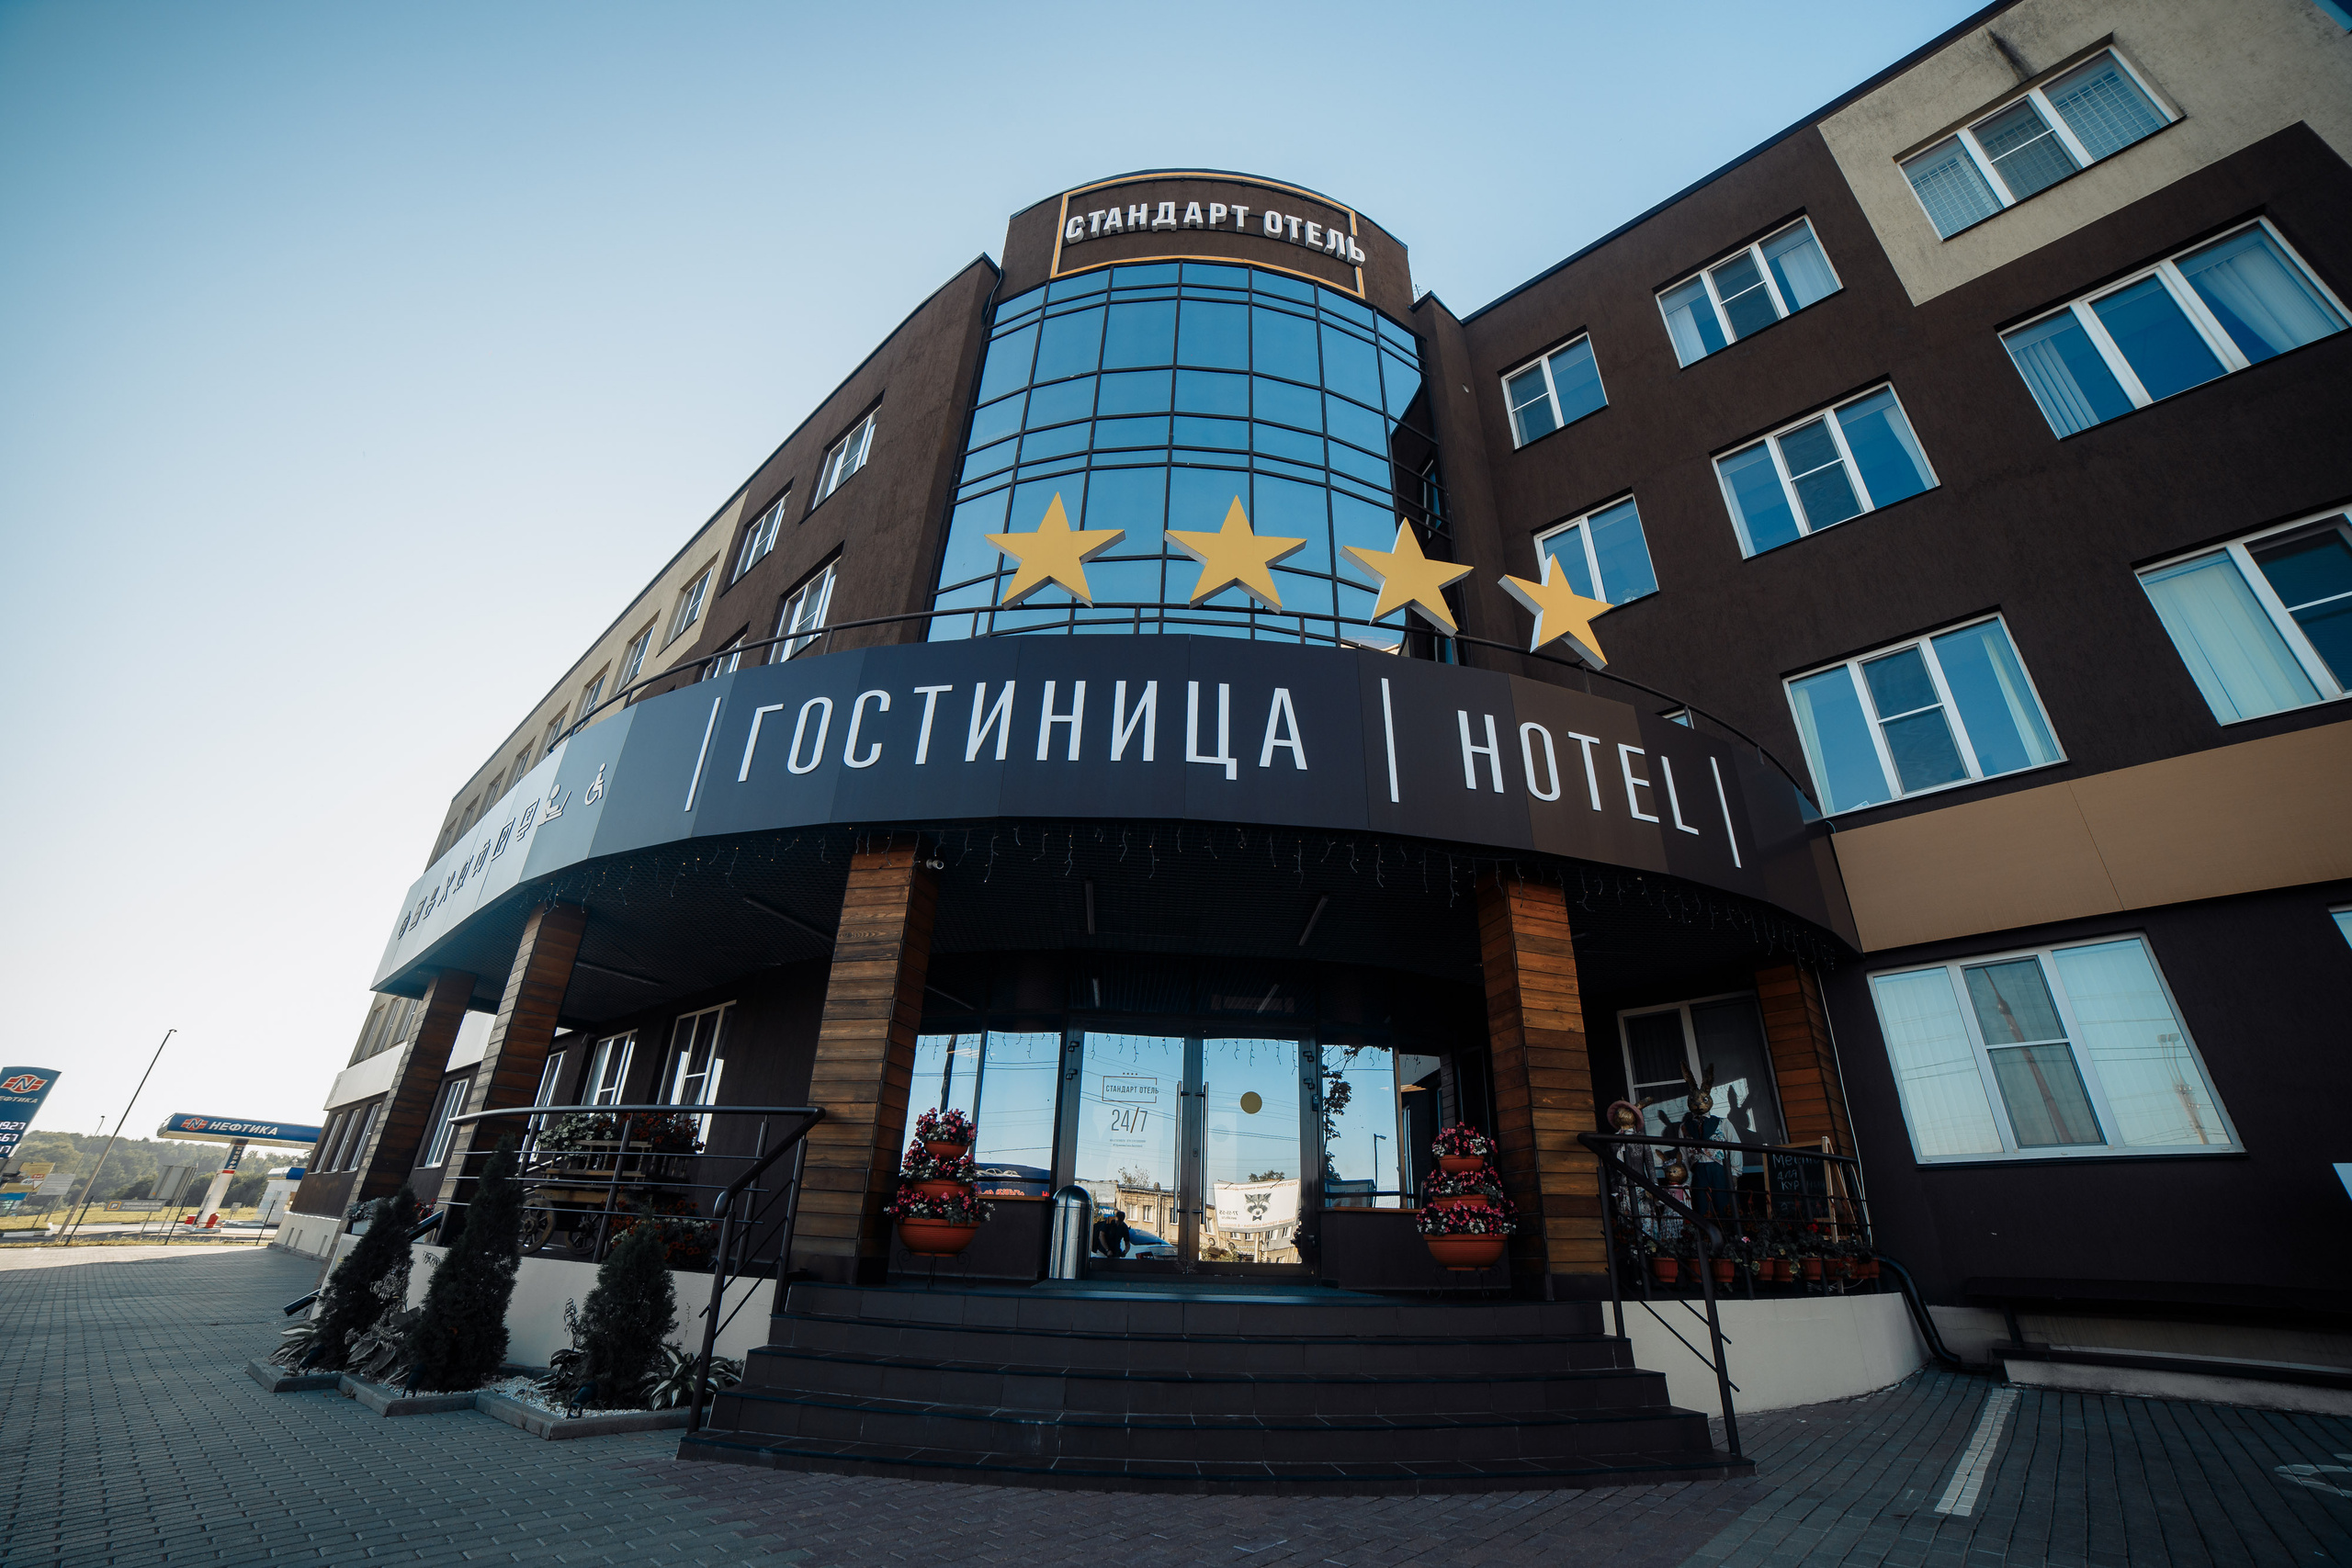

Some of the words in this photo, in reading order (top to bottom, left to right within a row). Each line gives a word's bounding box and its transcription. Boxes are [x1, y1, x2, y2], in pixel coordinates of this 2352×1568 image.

[1065, 201, 1250, 244] СТАНДАРТ
[1263, 209, 1366, 266] ОТЕЛЬ
[738, 680, 1308, 781] ГОСТИНИЦА
[1457, 709, 1700, 836] HOTEL
[0, 1095, 39, 1103] ЕФТИКА
[1105, 1085, 1137, 1094] СТАНДАРТ
[208, 1121, 279, 1136] НЕФТИКА
[1111, 1107, 1148, 1134] 24/7
